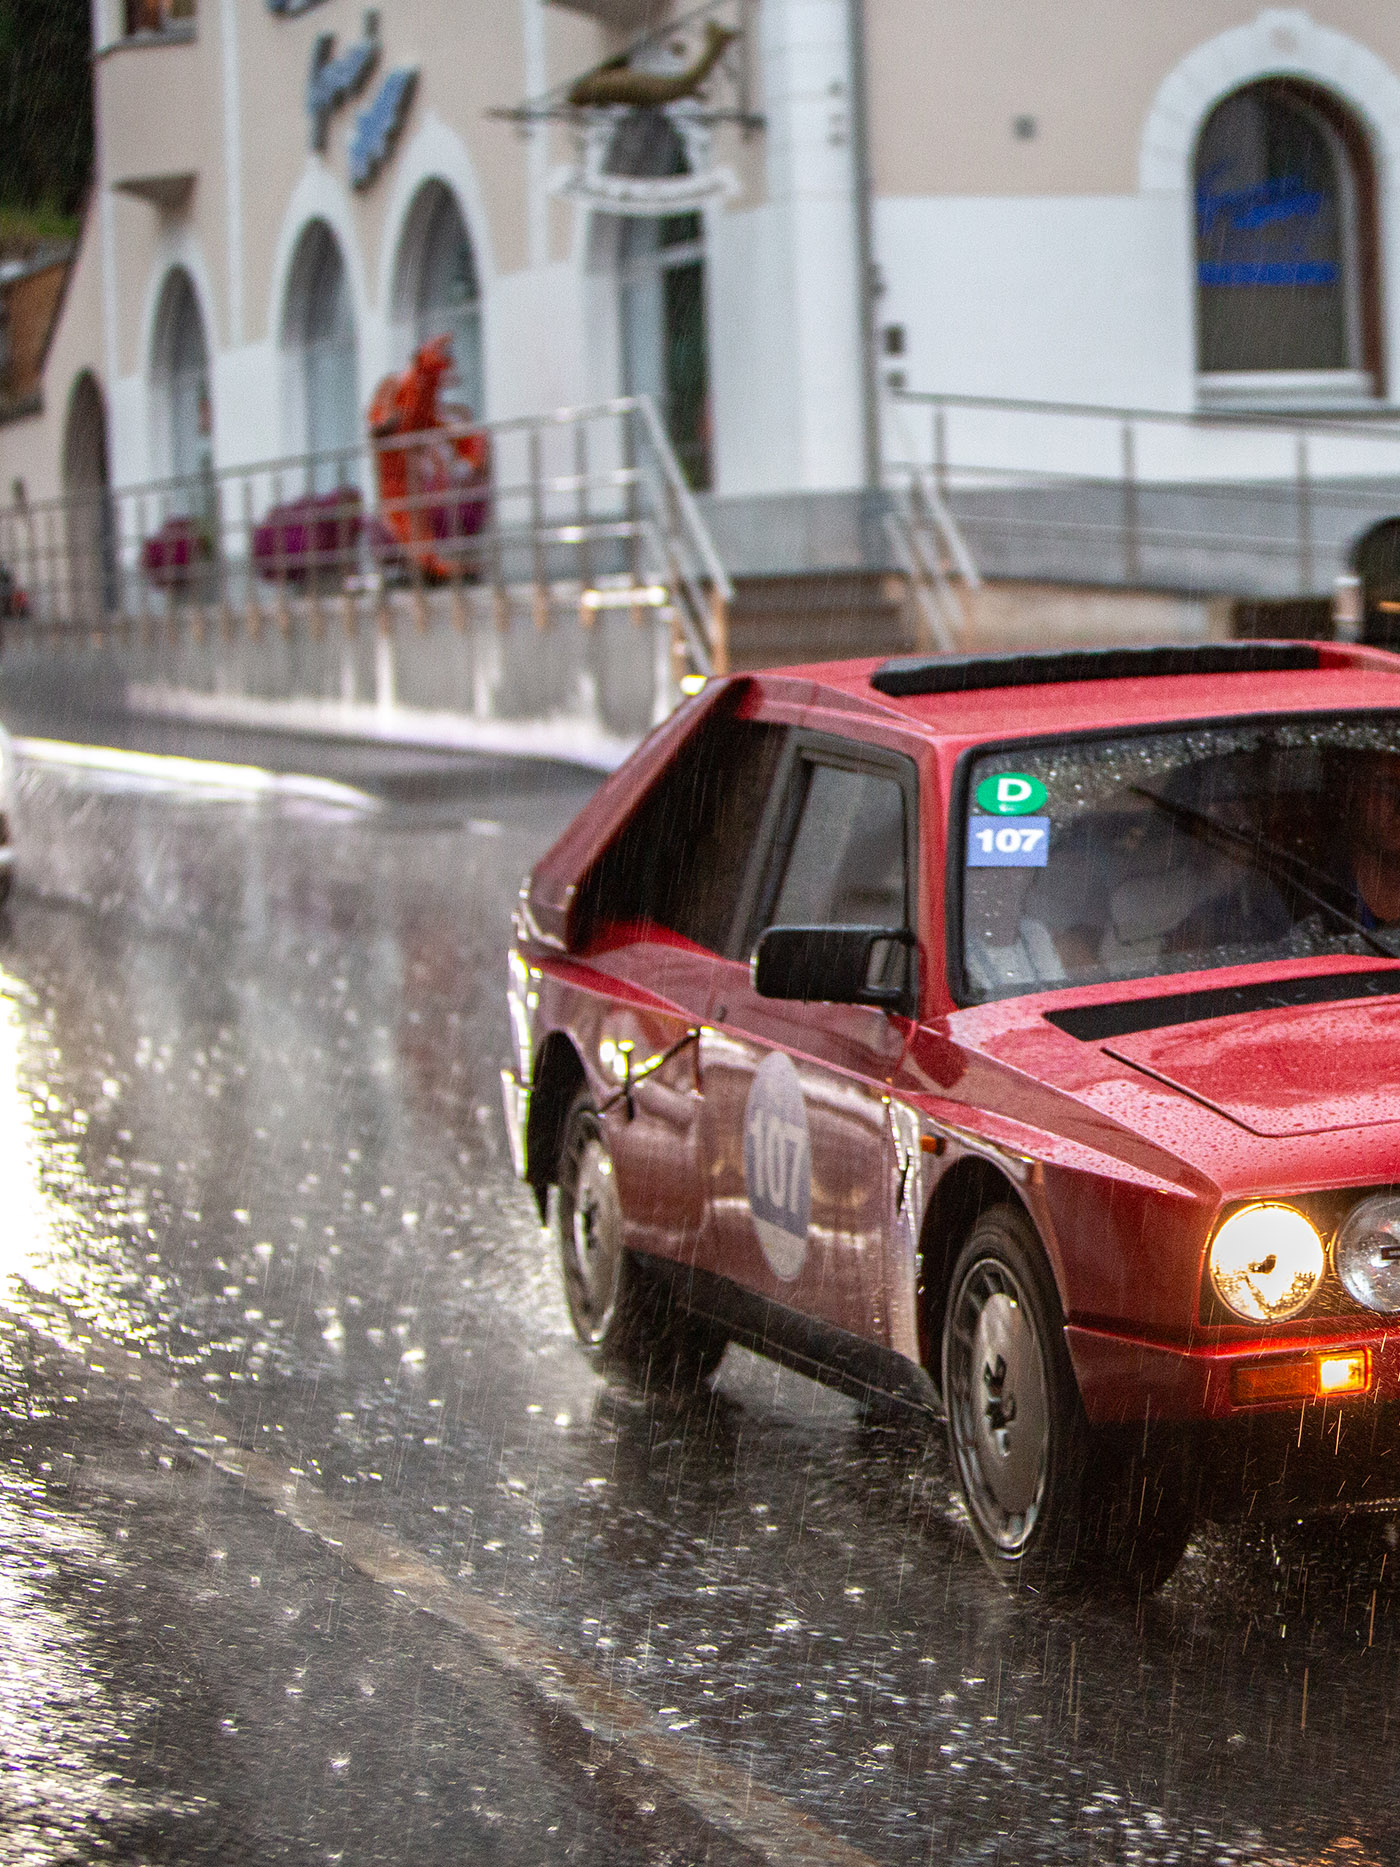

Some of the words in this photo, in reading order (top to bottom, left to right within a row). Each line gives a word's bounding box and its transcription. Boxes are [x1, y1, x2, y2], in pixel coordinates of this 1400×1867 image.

[997, 778, 1032, 802] D
[975, 828, 1044, 853] 107
[750, 1108, 805, 1213] 107
